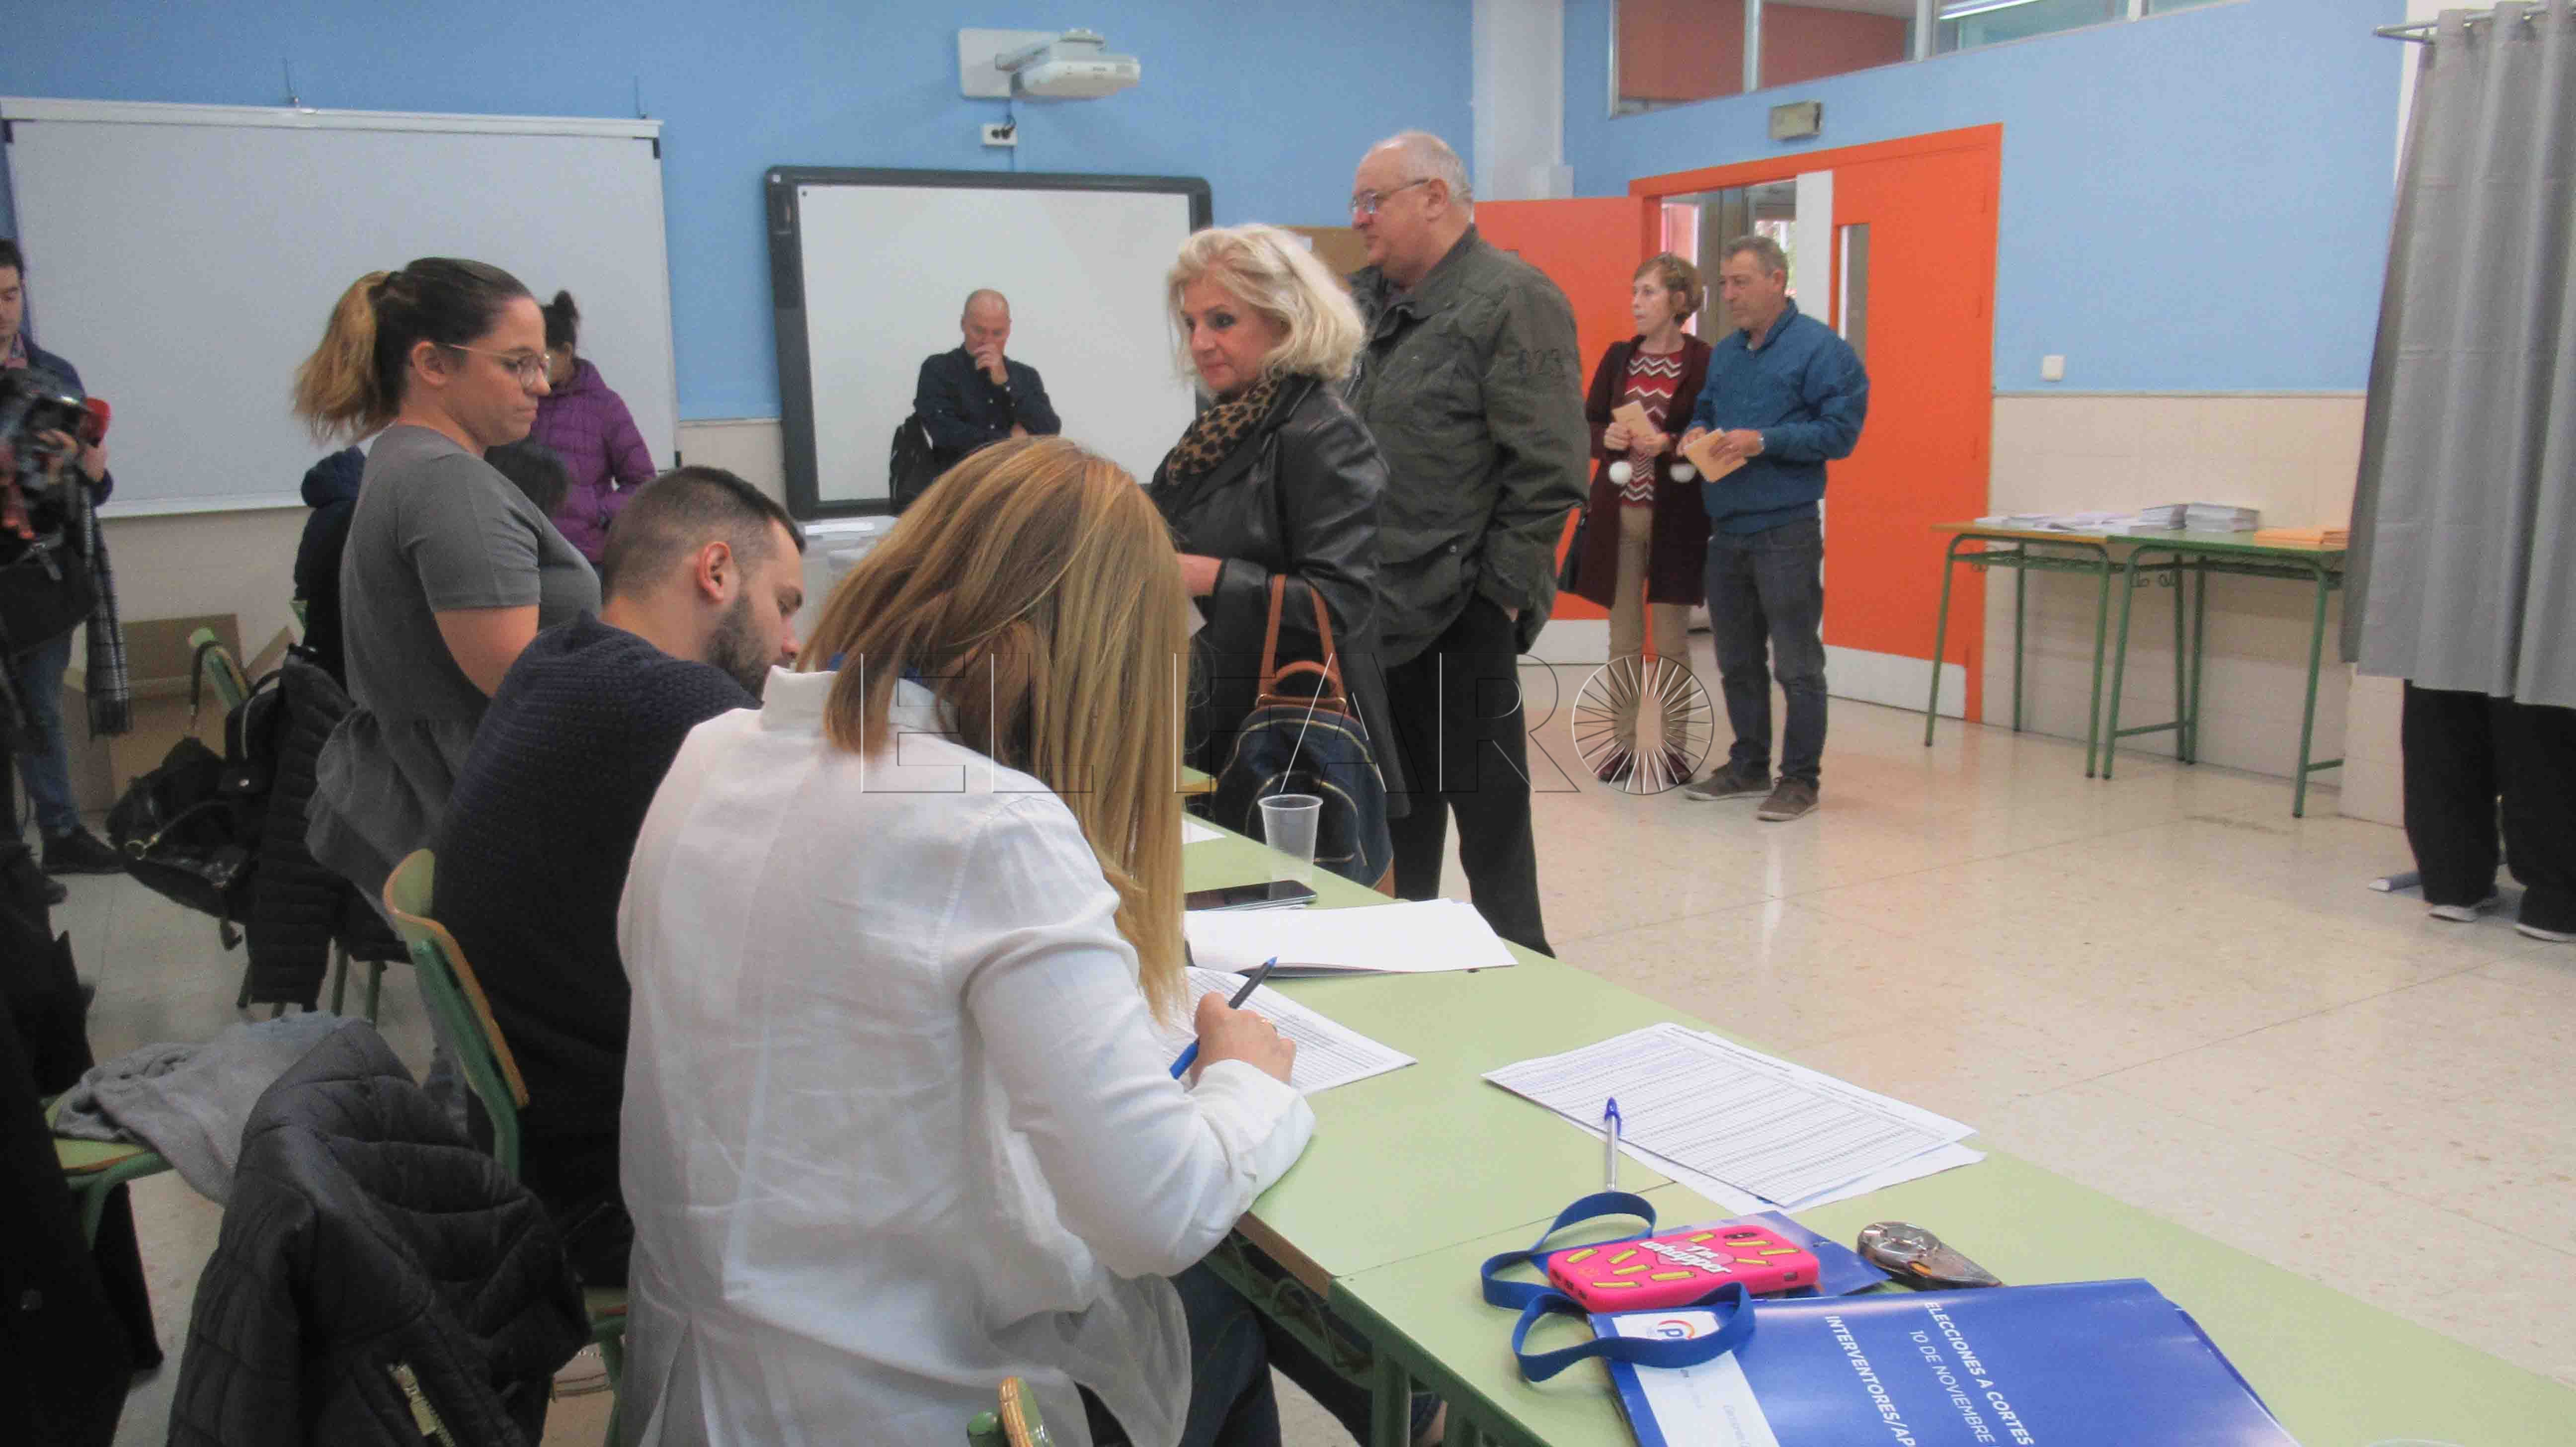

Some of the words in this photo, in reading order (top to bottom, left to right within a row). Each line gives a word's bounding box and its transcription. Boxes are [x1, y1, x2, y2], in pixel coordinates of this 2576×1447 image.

[1910, 1330, 1929, 1343] 10
[1919, 1346, 1943, 1364] DE
[1924, 1301, 1986, 1376] ELECCIONES
[1975, 1378, 1994, 1388] A
[1986, 1391, 2035, 1445] CORTES
[1932, 1365, 1996, 1443] NOVIEMBRE
